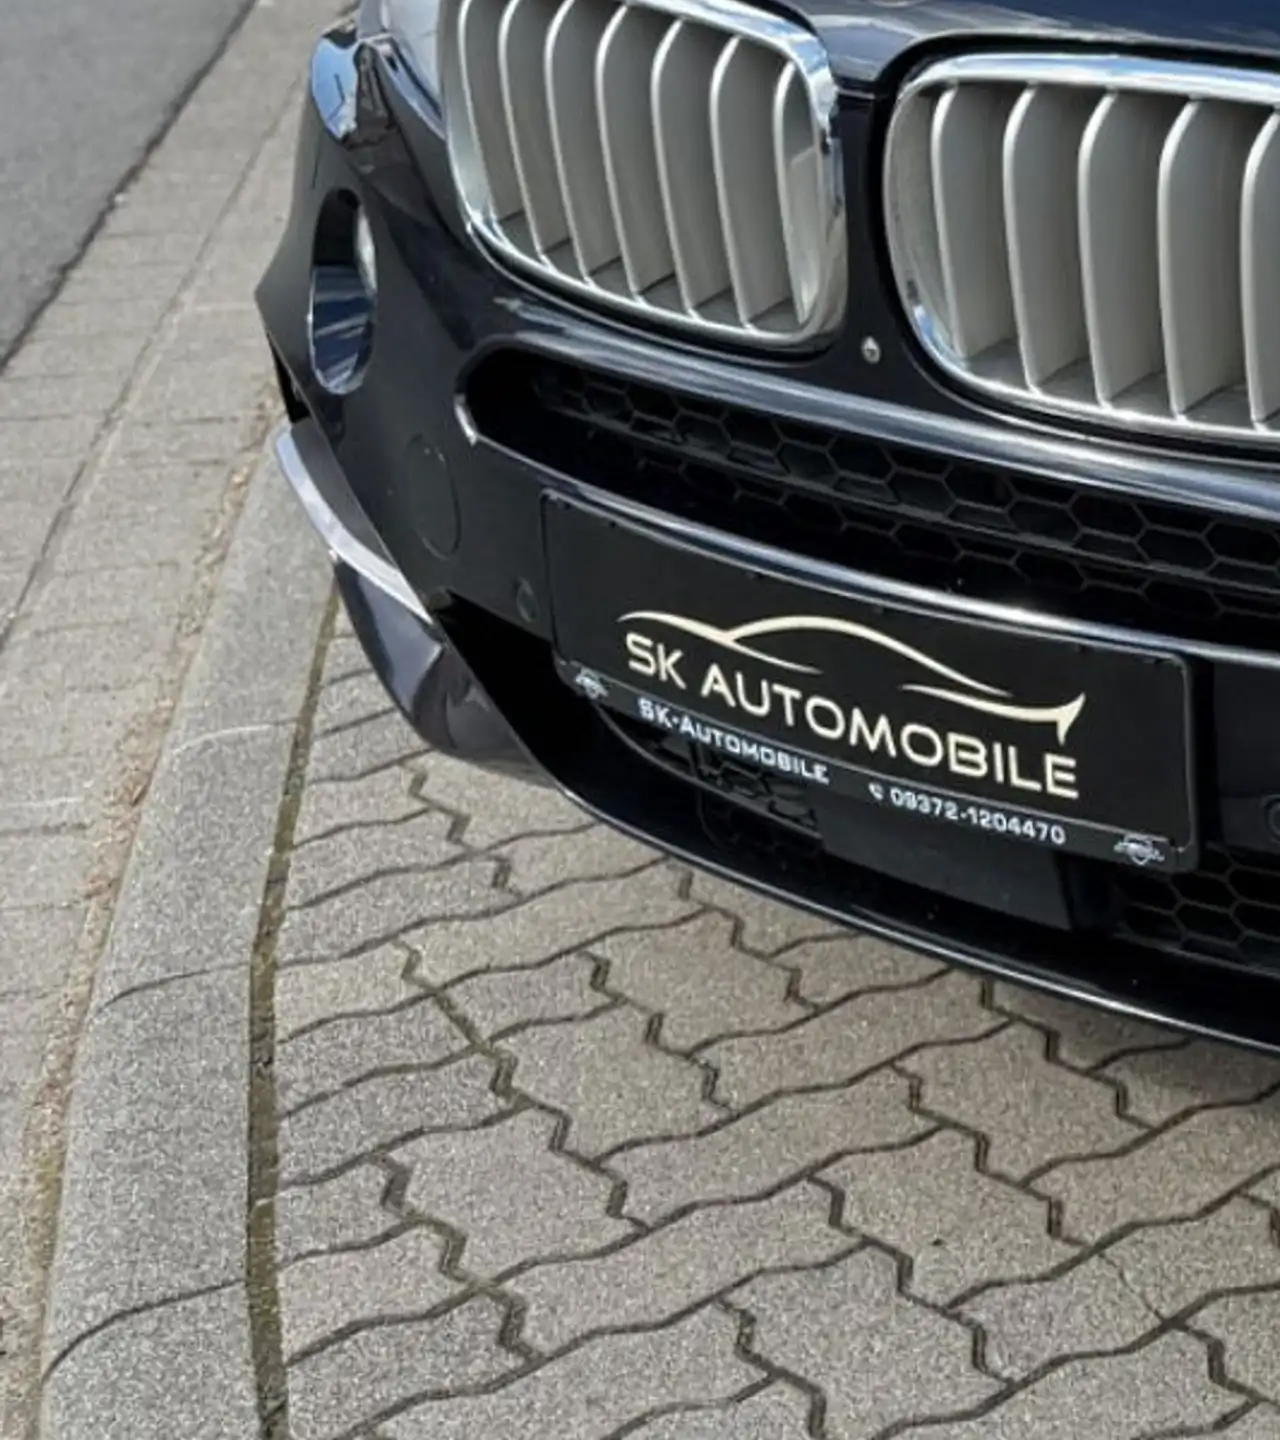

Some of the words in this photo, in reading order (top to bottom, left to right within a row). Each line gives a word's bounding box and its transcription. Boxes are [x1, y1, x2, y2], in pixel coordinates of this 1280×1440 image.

[626, 632, 687, 690] SK
[701, 662, 1079, 800] AUTOMOBILE
[637, 696, 830, 785] SK-AUTOMOBILE
[890, 787, 1066, 845] 09372-1204470
